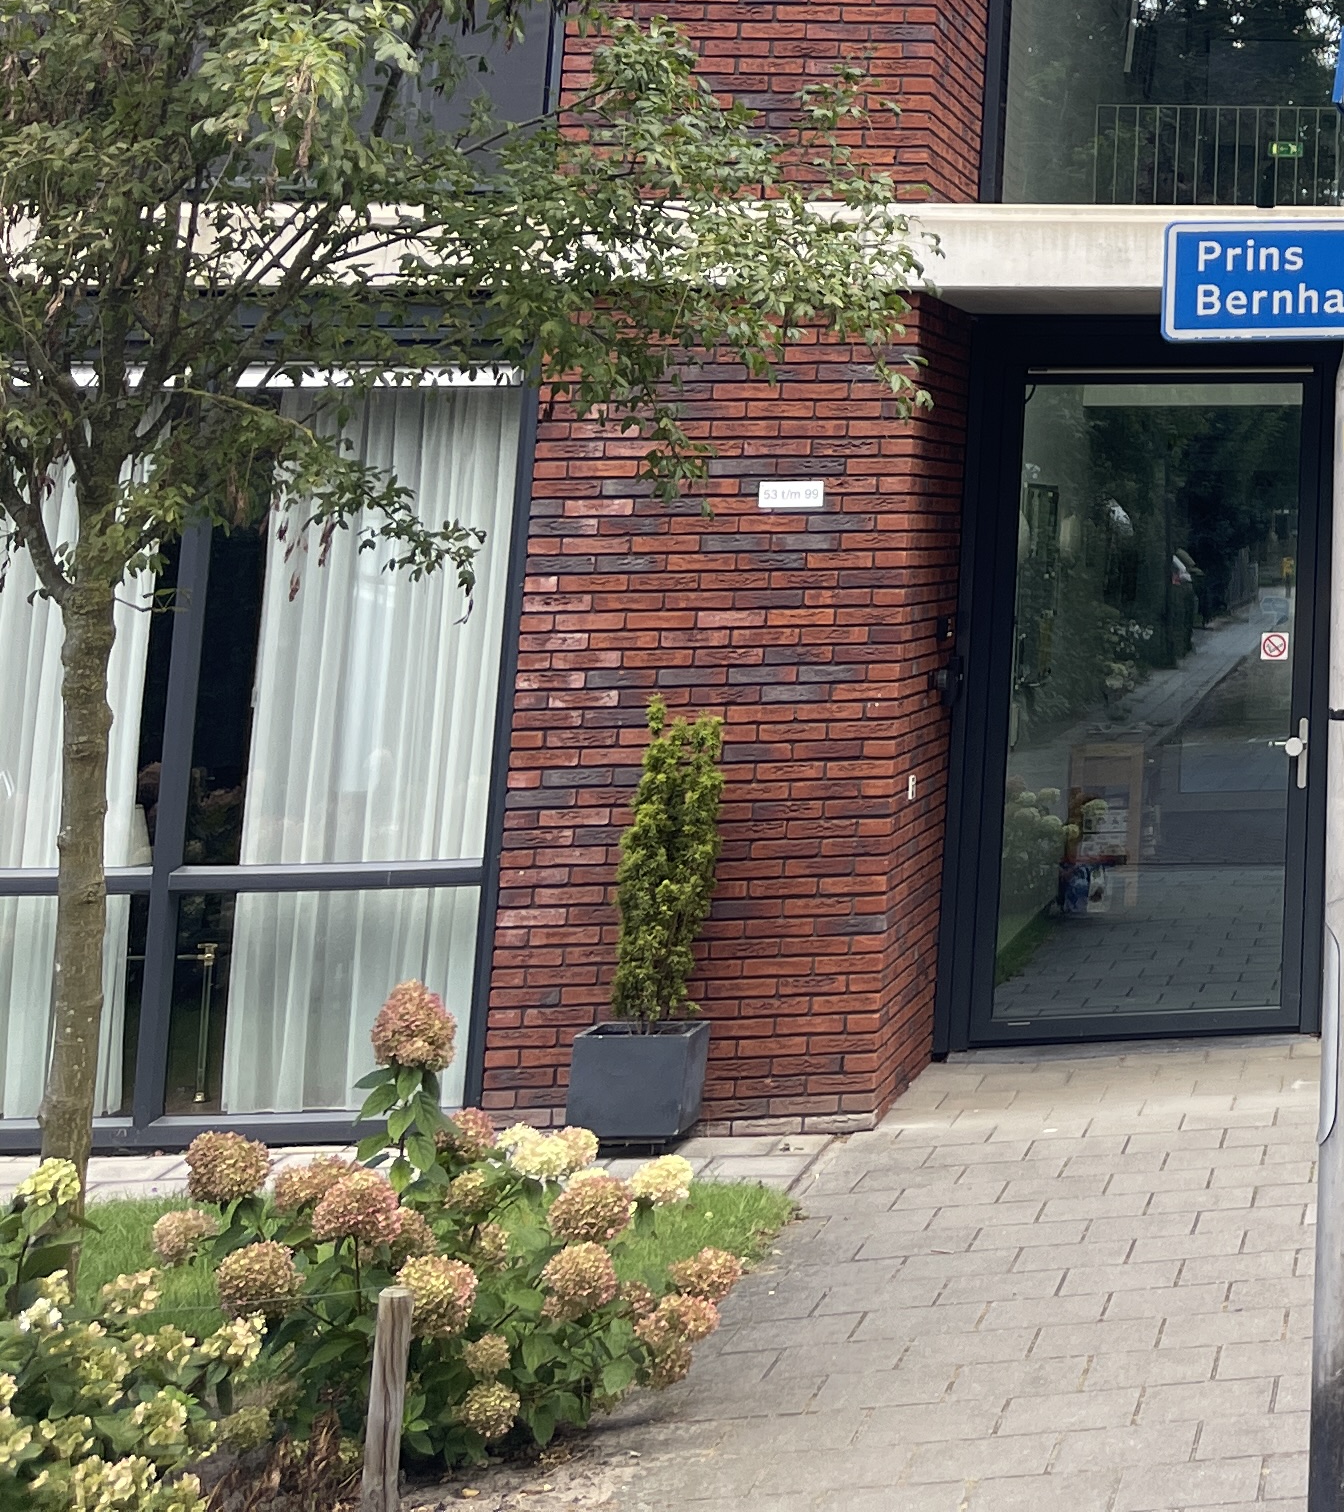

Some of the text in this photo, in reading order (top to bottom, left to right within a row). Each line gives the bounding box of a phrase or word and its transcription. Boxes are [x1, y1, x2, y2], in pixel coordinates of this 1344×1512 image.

[1197, 239, 1304, 272] Prins
[763, 489, 819, 500] 53 t/m 99
